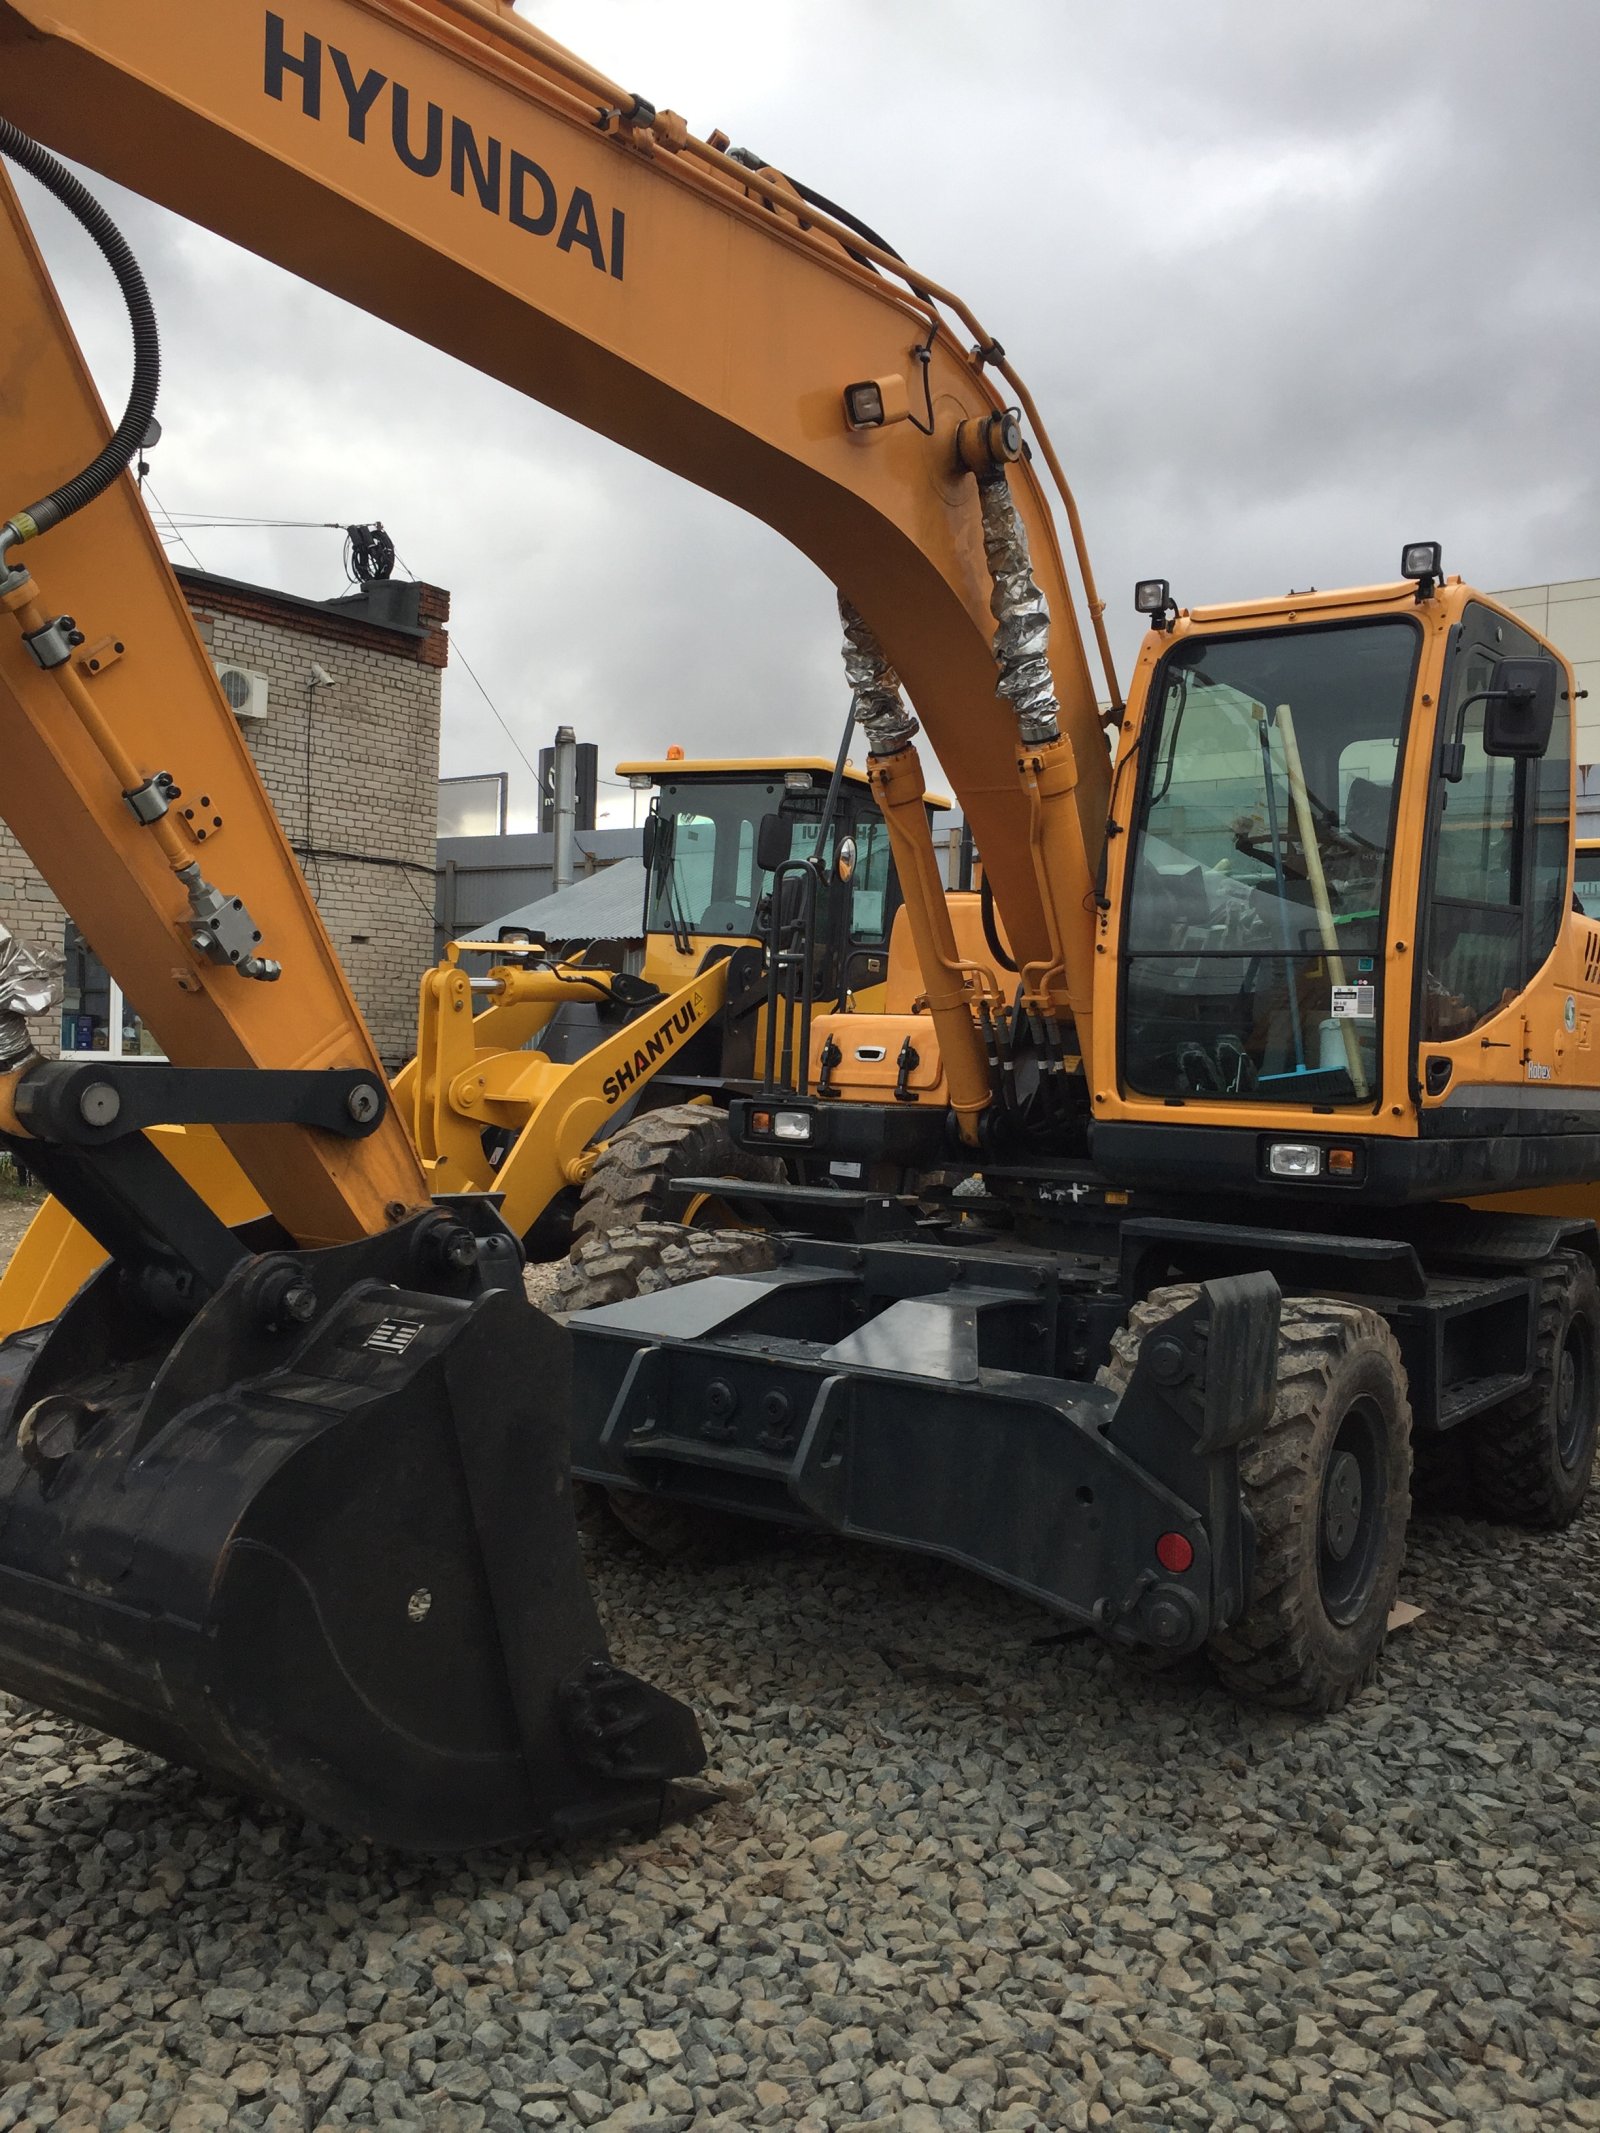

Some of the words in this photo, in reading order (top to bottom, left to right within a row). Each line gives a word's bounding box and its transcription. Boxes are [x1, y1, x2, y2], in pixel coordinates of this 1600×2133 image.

[264, 10, 625, 281] HYUNDAI
[602, 1000, 697, 1104] SHANTUI
[1527, 1060, 1551, 1079] Robex
